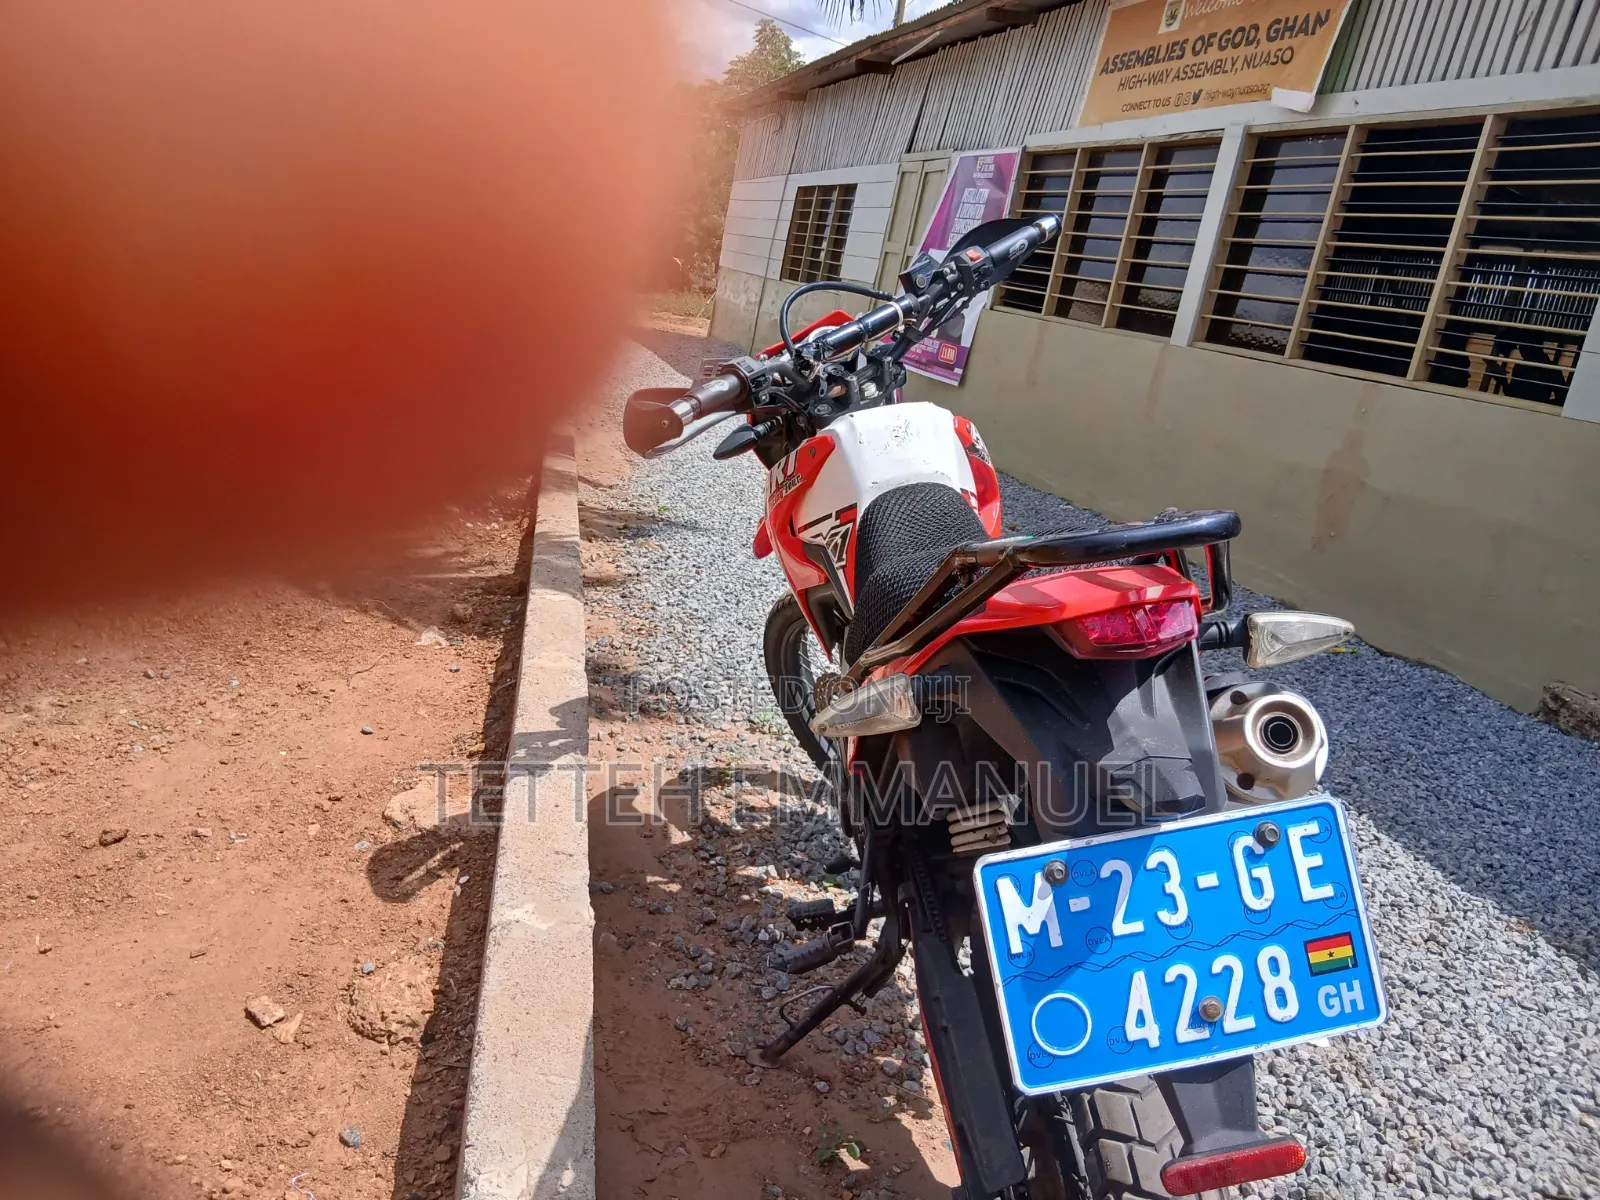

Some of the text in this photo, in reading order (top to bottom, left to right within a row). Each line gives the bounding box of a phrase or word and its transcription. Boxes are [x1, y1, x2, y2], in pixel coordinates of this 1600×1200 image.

[1099, 36, 1188, 76] ASSEMBLIES
[1192, 32, 1218, 56] OF
[1218, 23, 1260, 51] GOD,
[1117, 46, 1295, 92] HIGH-WAY ASSEMBLY, NUASO
[1121, 100, 1152, 113] CONNECT
[1151, 99, 1162, 108] TO
[1161, 97, 1171, 107] US
[1073, 868, 1096, 879] DVLA
[1087, 936, 1111, 946] DVLA
[1124, 945, 1301, 1049] 4228
[1317, 979, 1365, 1018] GH
